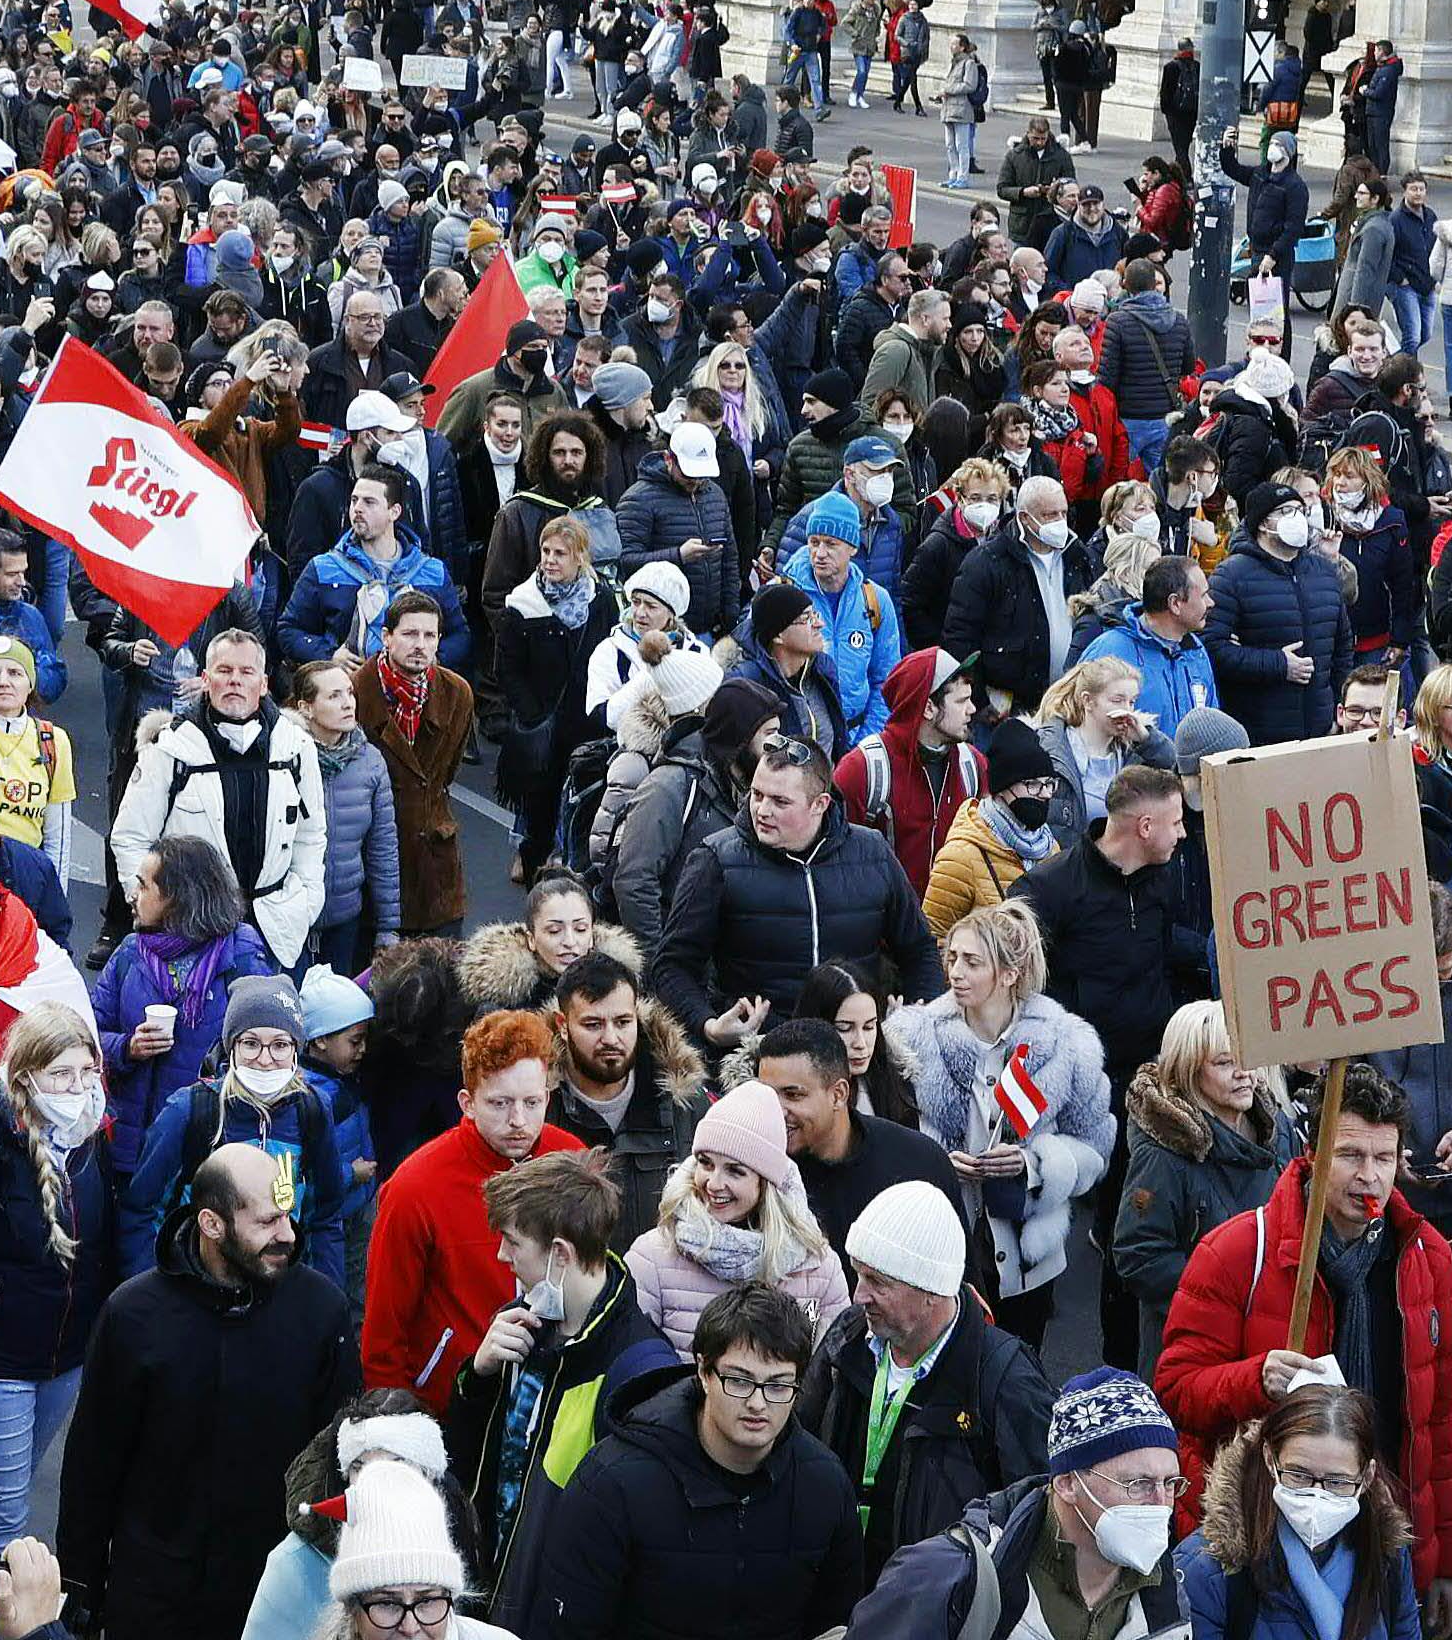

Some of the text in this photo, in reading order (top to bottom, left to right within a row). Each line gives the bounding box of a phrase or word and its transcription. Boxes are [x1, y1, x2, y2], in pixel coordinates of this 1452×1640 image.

[86, 436, 198, 519] Stiegl
[1264, 791, 1364, 873] NO
[1232, 867, 1414, 950] GREEN
[1267, 955, 1421, 1033] PASS
